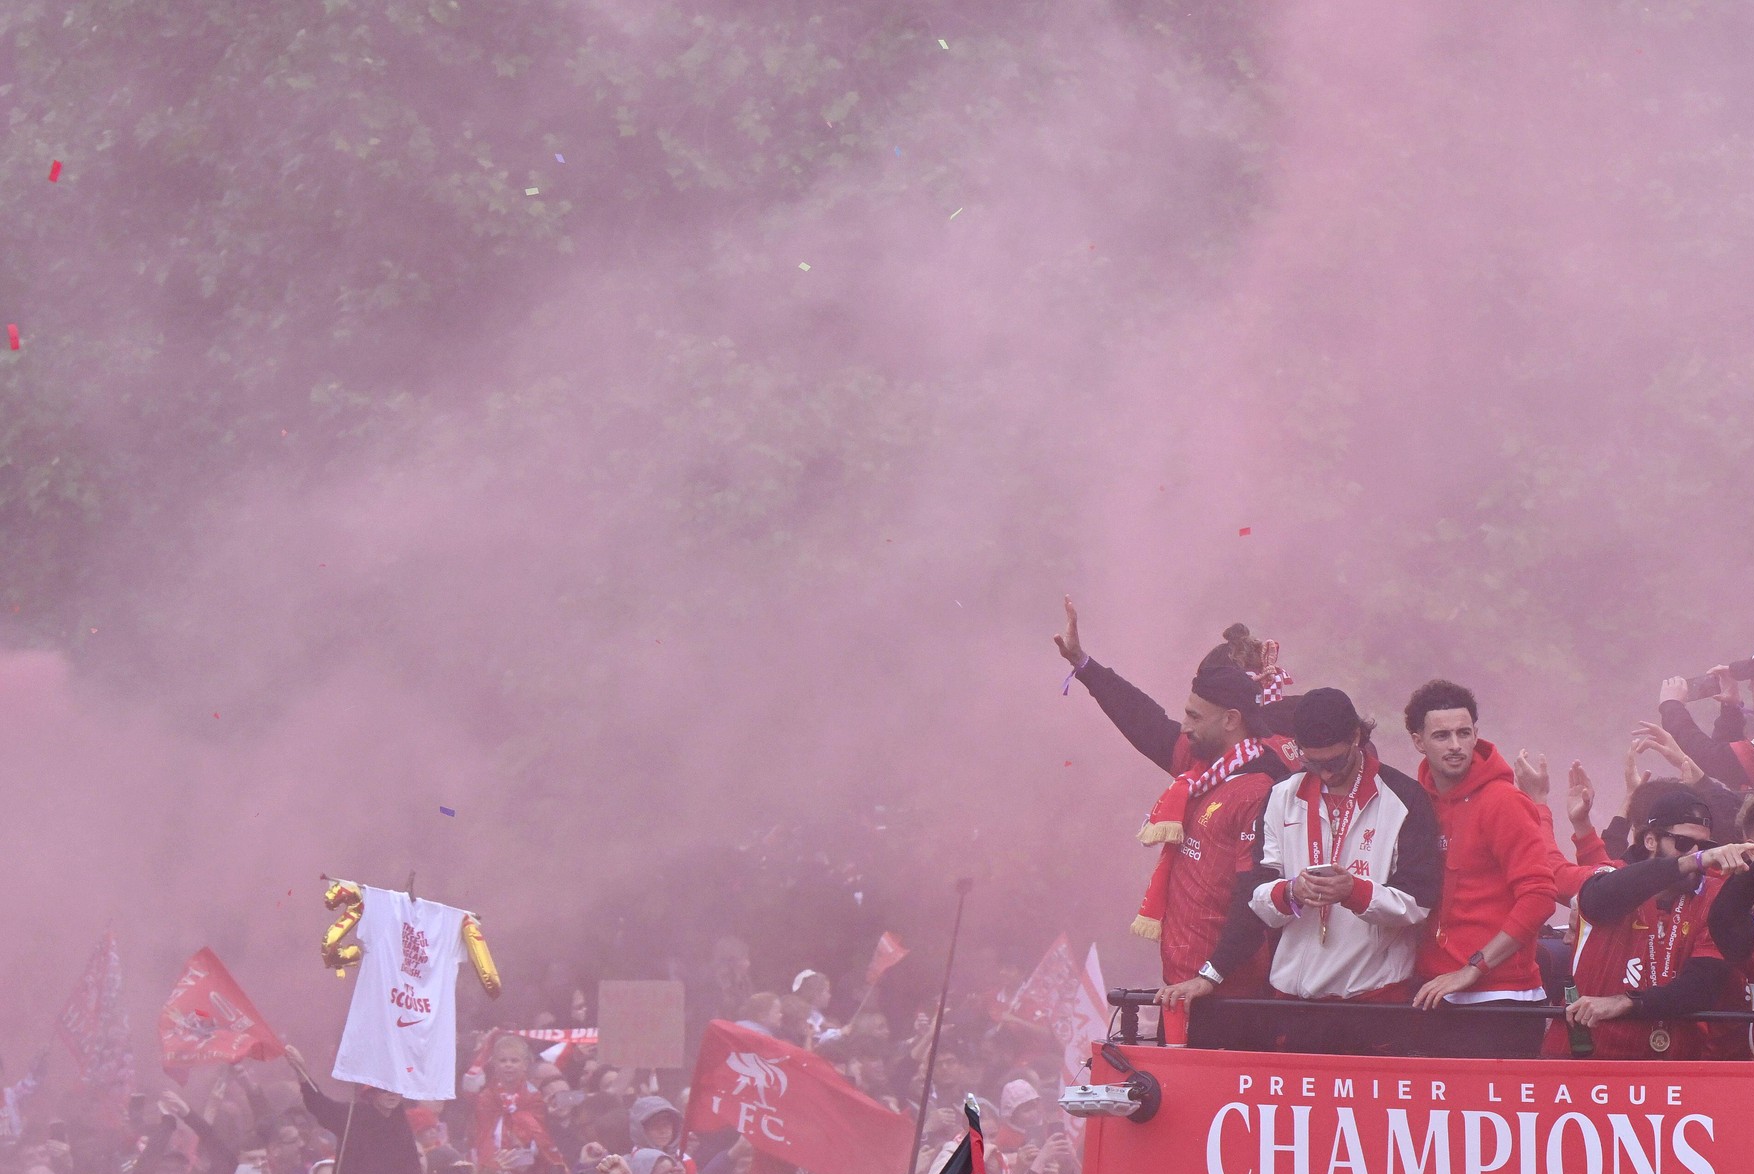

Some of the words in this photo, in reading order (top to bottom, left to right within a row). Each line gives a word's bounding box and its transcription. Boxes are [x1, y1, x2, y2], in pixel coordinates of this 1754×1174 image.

[1346, 859, 1370, 876] AXA
[391, 987, 431, 1013] SCOUSE
[1239, 1075, 1448, 1100] PREMIER
[1488, 1083, 1686, 1107] LEAGUE
